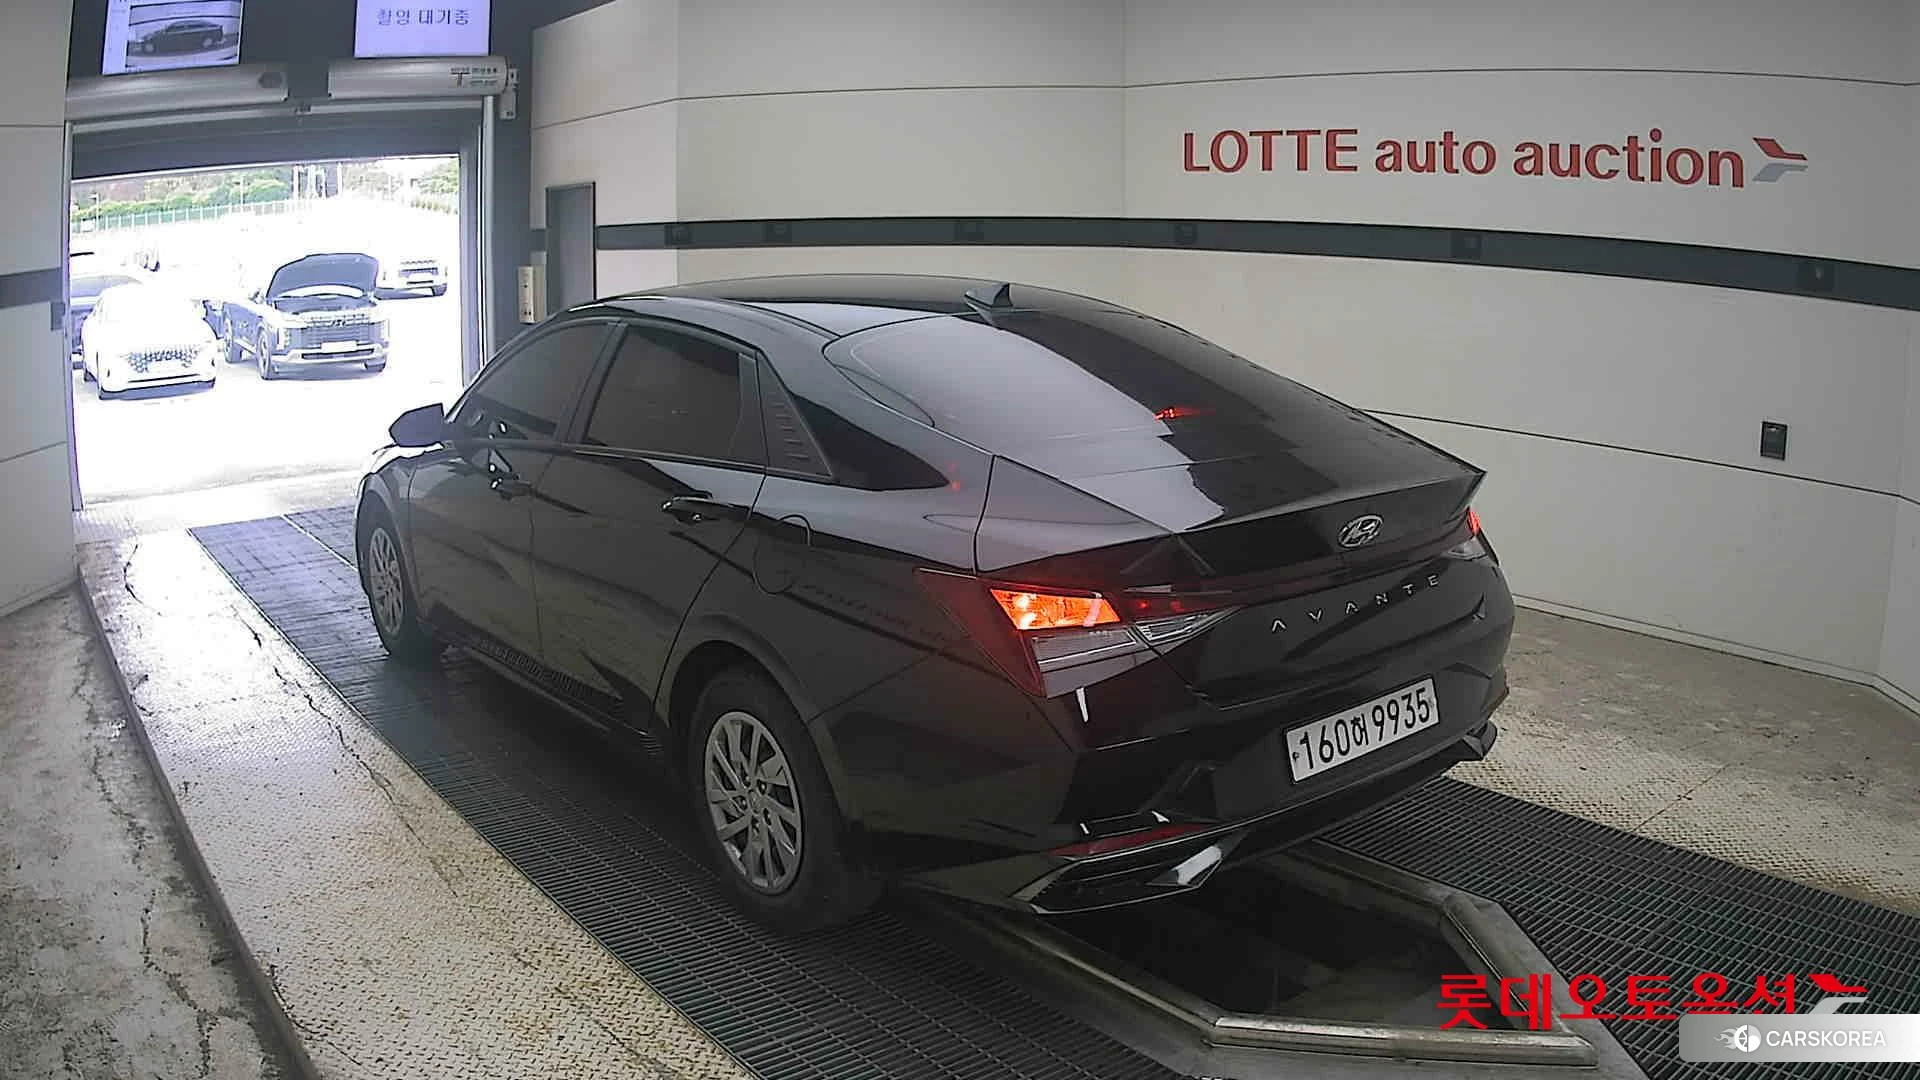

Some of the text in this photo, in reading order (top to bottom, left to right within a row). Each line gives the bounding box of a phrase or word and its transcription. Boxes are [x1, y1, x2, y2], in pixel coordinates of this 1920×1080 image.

[418, 8, 471, 26] 대기중
[1184, 128, 1744, 188] LOTTE auto auction
[1271, 573, 1440, 633] AVANTE
